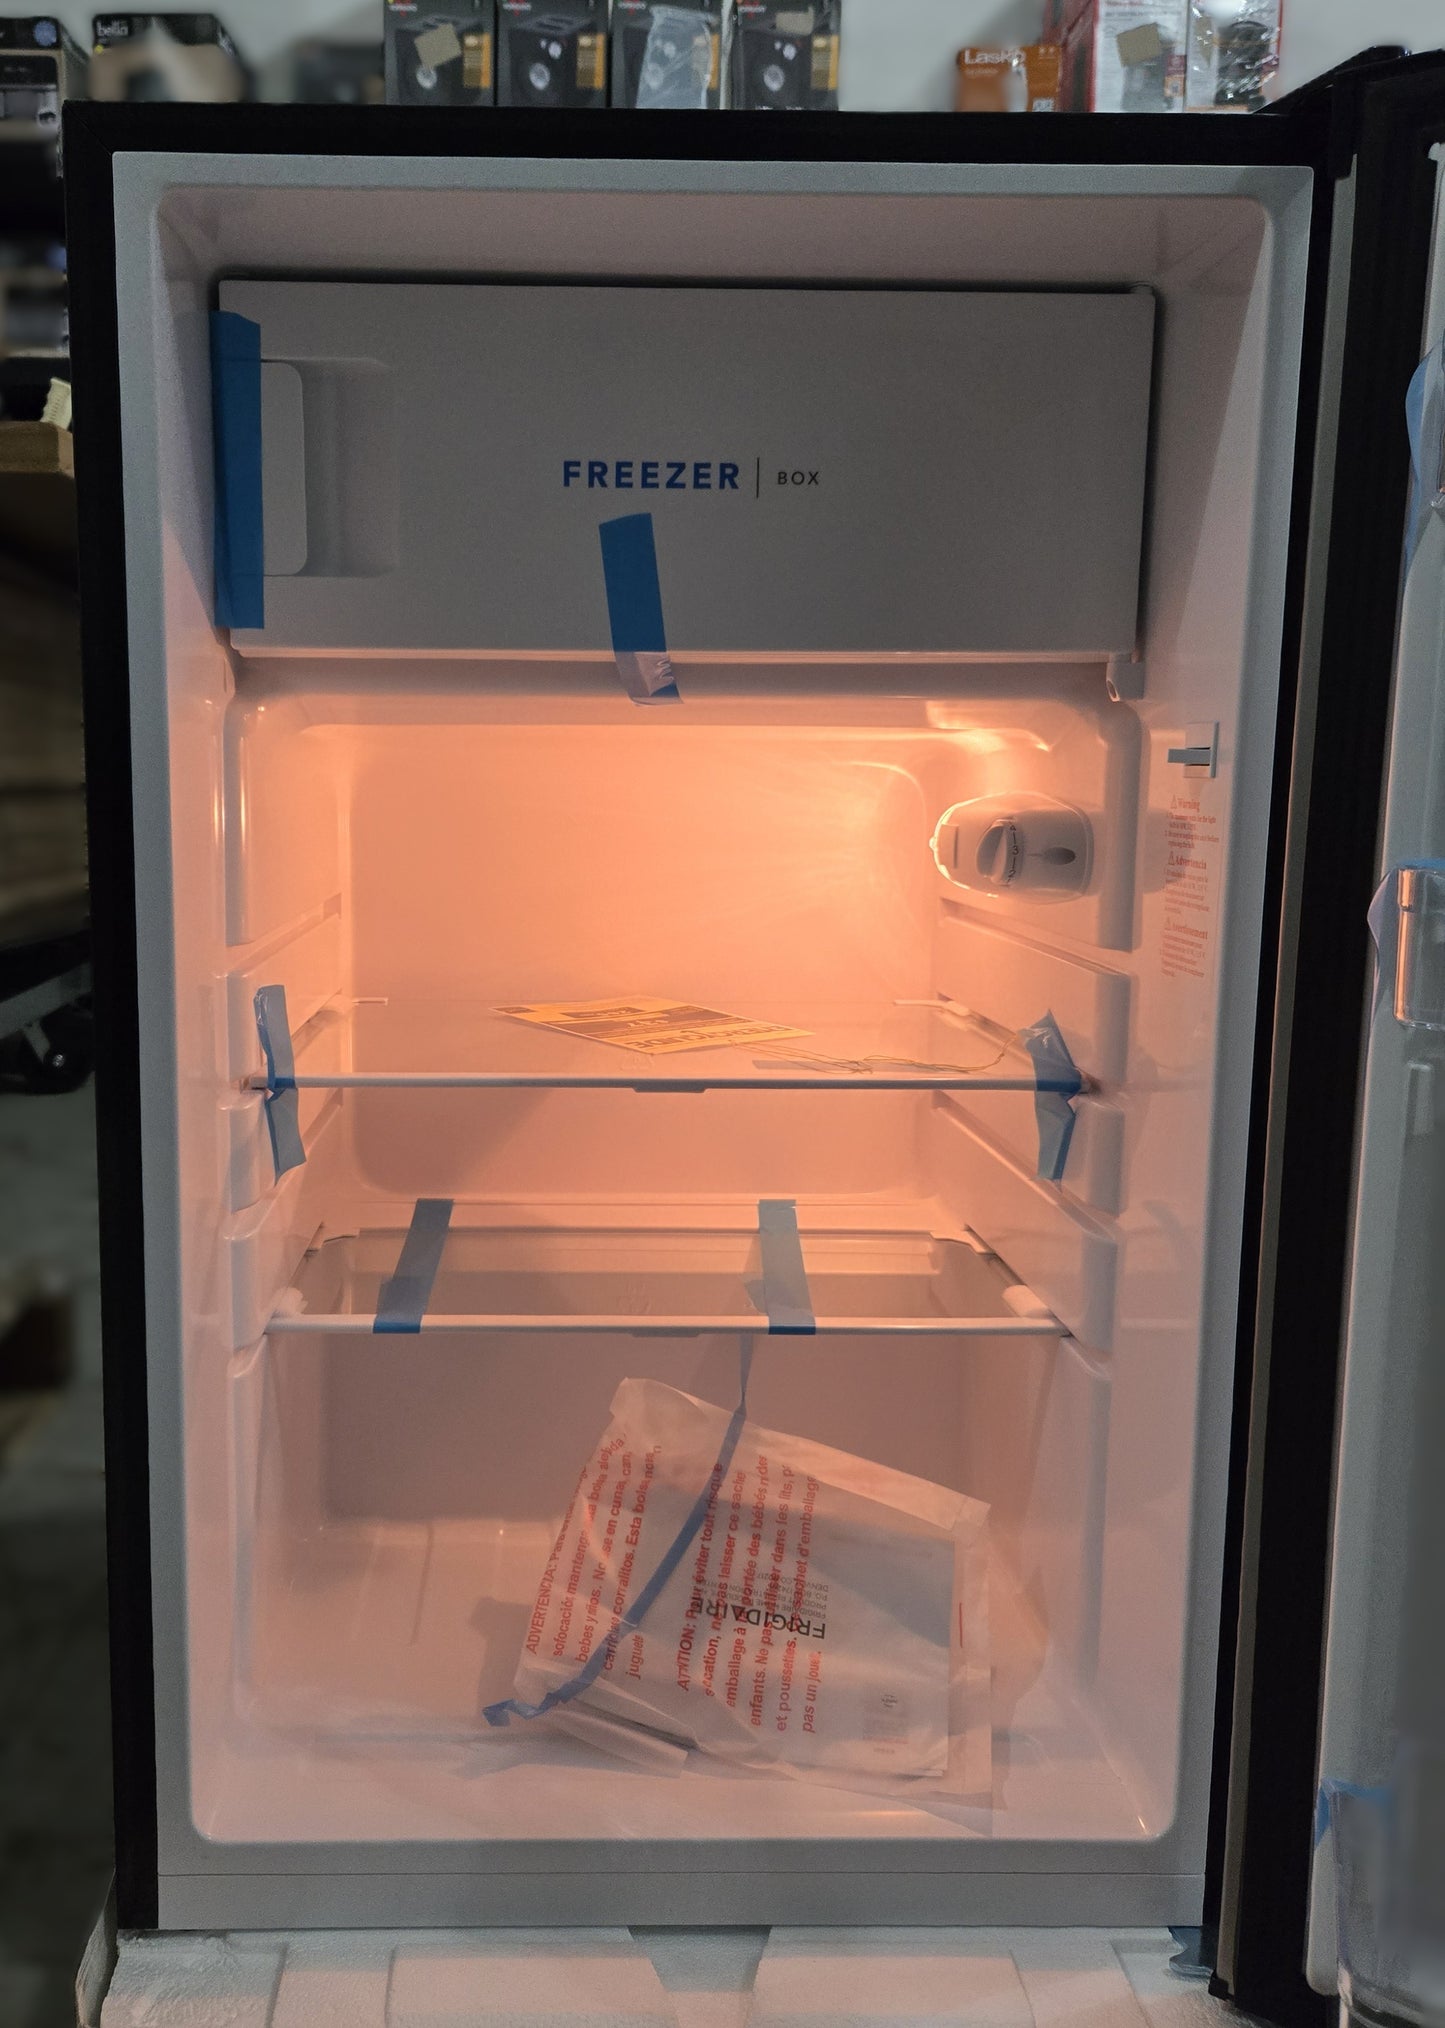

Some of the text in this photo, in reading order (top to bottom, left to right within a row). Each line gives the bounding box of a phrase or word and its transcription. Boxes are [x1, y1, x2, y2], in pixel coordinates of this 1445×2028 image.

[562, 460, 820, 490] FREEZER BOX
[700, 1512, 716, 1543] tout
[729, 1513, 740, 1532] ce
[751, 1487, 768, 1530] bébés
[775, 1502, 789, 1526] les
[692, 1543, 711, 1585] éviter
[717, 1534, 737, 1578] laisser
[746, 1532, 761, 1557] des
[771, 1527, 787, 1564] dans
[613, 1549, 635, 1616] corralitos.
[625, 1516, 642, 1546] Esta
[741, 1559, 757, 1607] portée
[525, 1564, 558, 1656] ADVERTENCIA:
[574, 1624, 595, 1664] bebes
[606, 1518, 618, 1536] en
[716, 1581, 728, 1608] pas
[691, 1597, 826, 1640] FRIGIDAIRE
[761, 1620, 774, 1647] pas
[755, 1647, 770, 1665] Ne
[776, 1714, 788, 1732] et
[792, 1559, 809, 1611] sachet
[726, 1637, 746, 1708] emballage
[749, 1667, 767, 1727] enfants.
[805, 1683, 818, 1703] un
[801, 1705, 817, 1735] pas
